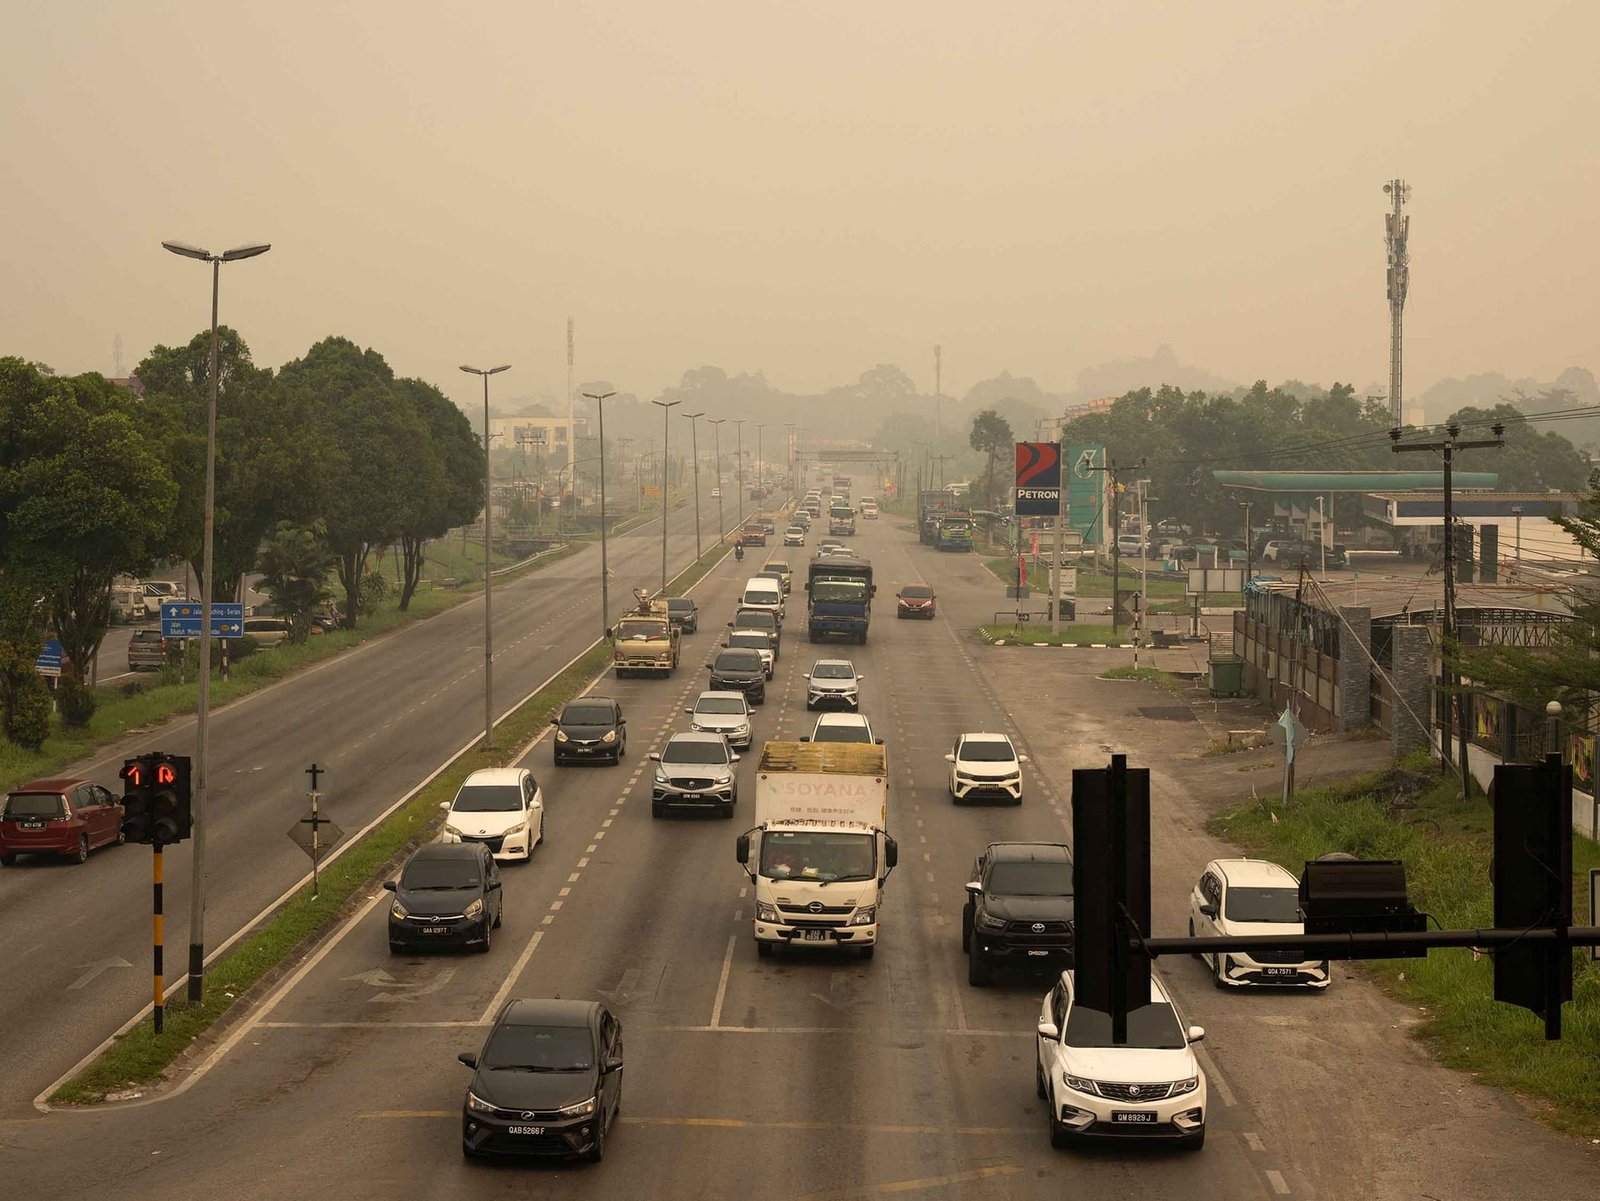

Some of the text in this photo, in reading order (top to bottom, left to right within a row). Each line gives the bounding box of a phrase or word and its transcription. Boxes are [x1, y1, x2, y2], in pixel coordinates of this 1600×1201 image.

[1018, 489, 1058, 499] PETRON
[786, 782, 867, 797] SOYANA
[1117, 1113, 1151, 1122] QM 8929 J
[508, 1126, 545, 1135] QAB 5266 F
